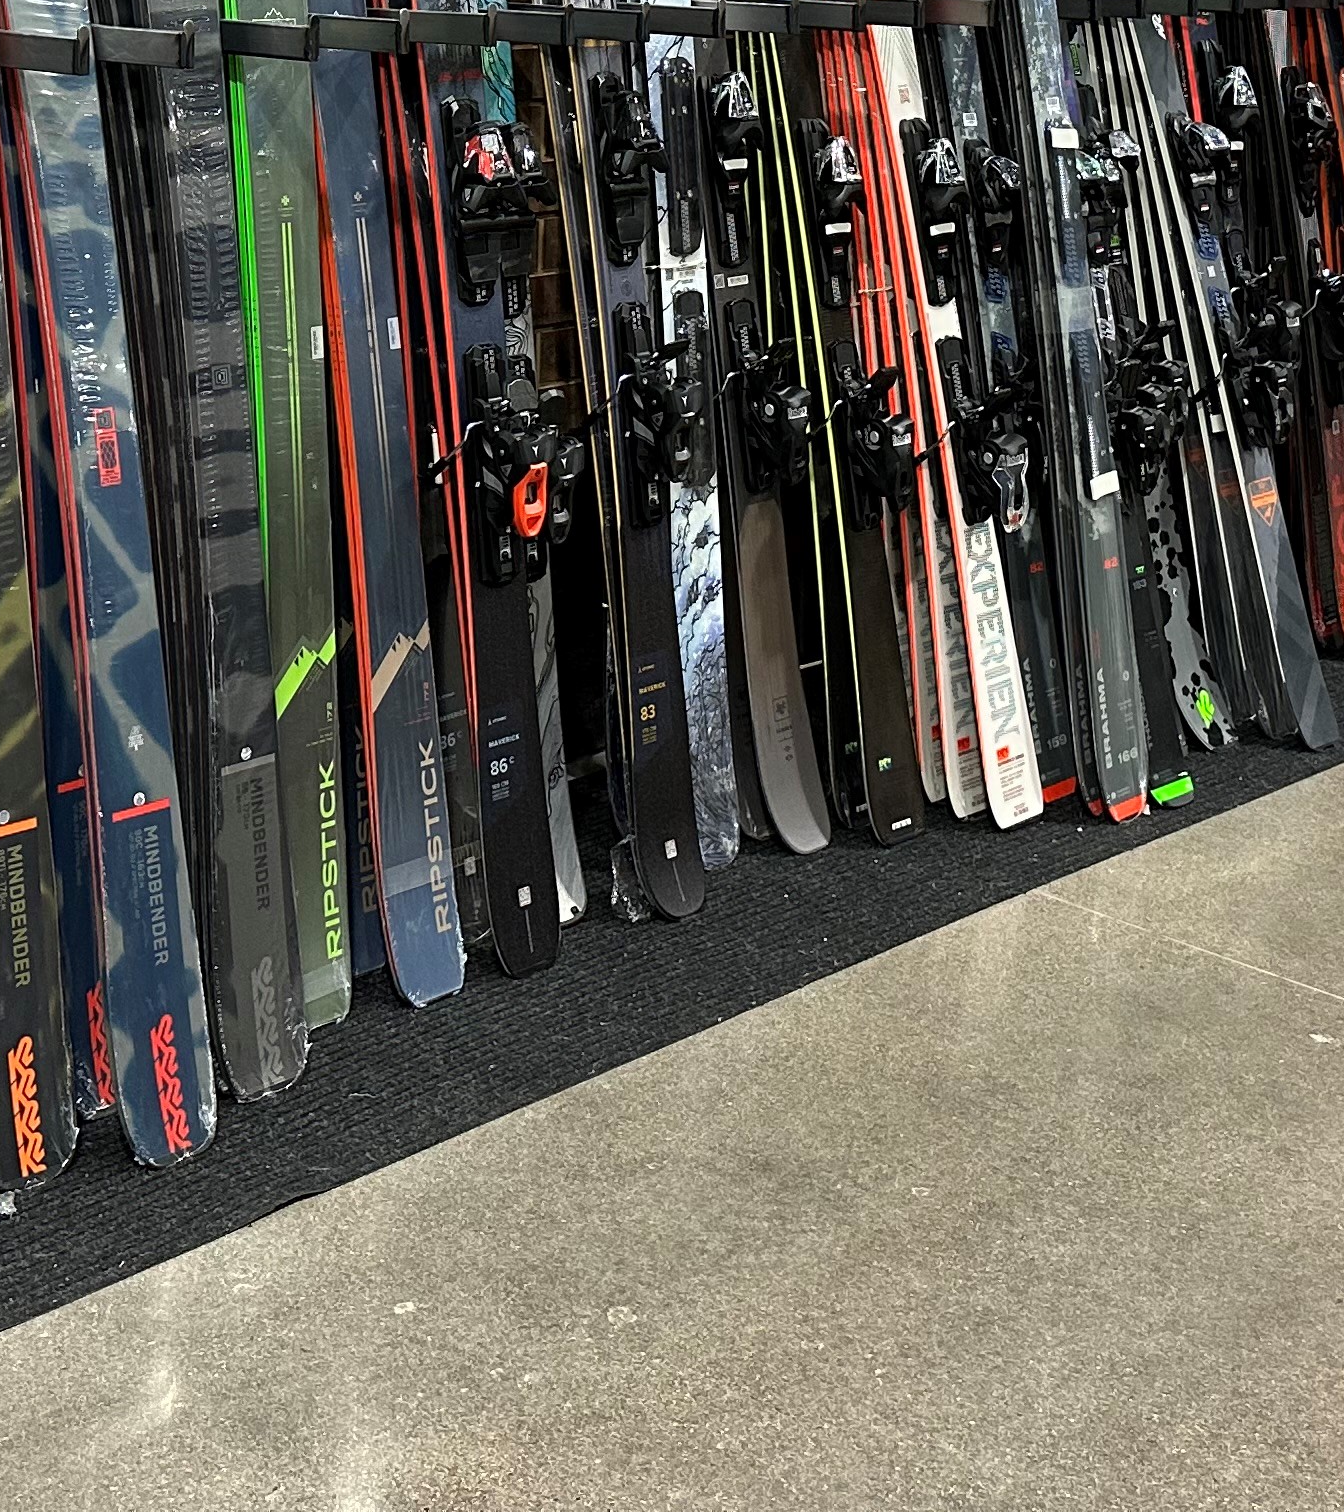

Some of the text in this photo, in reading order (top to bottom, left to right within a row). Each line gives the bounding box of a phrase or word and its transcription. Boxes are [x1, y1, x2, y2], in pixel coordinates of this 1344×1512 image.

[487, 732, 521, 749] MAVERICK
[639, 703, 657, 722] 83
[1022, 656, 1043, 755] BRAHMA
[1096, 666, 1114, 770] BRAHMA
[1117, 746, 1139, 766] 166
[248, 776, 271, 912] MINDBENDER
[318, 757, 344, 961] RIPSTICK
[417, 736, 454, 935] RIPSTICK
[7, 843, 32, 989] MINDBENDER
[142, 824, 170, 968] MINDBENDER
